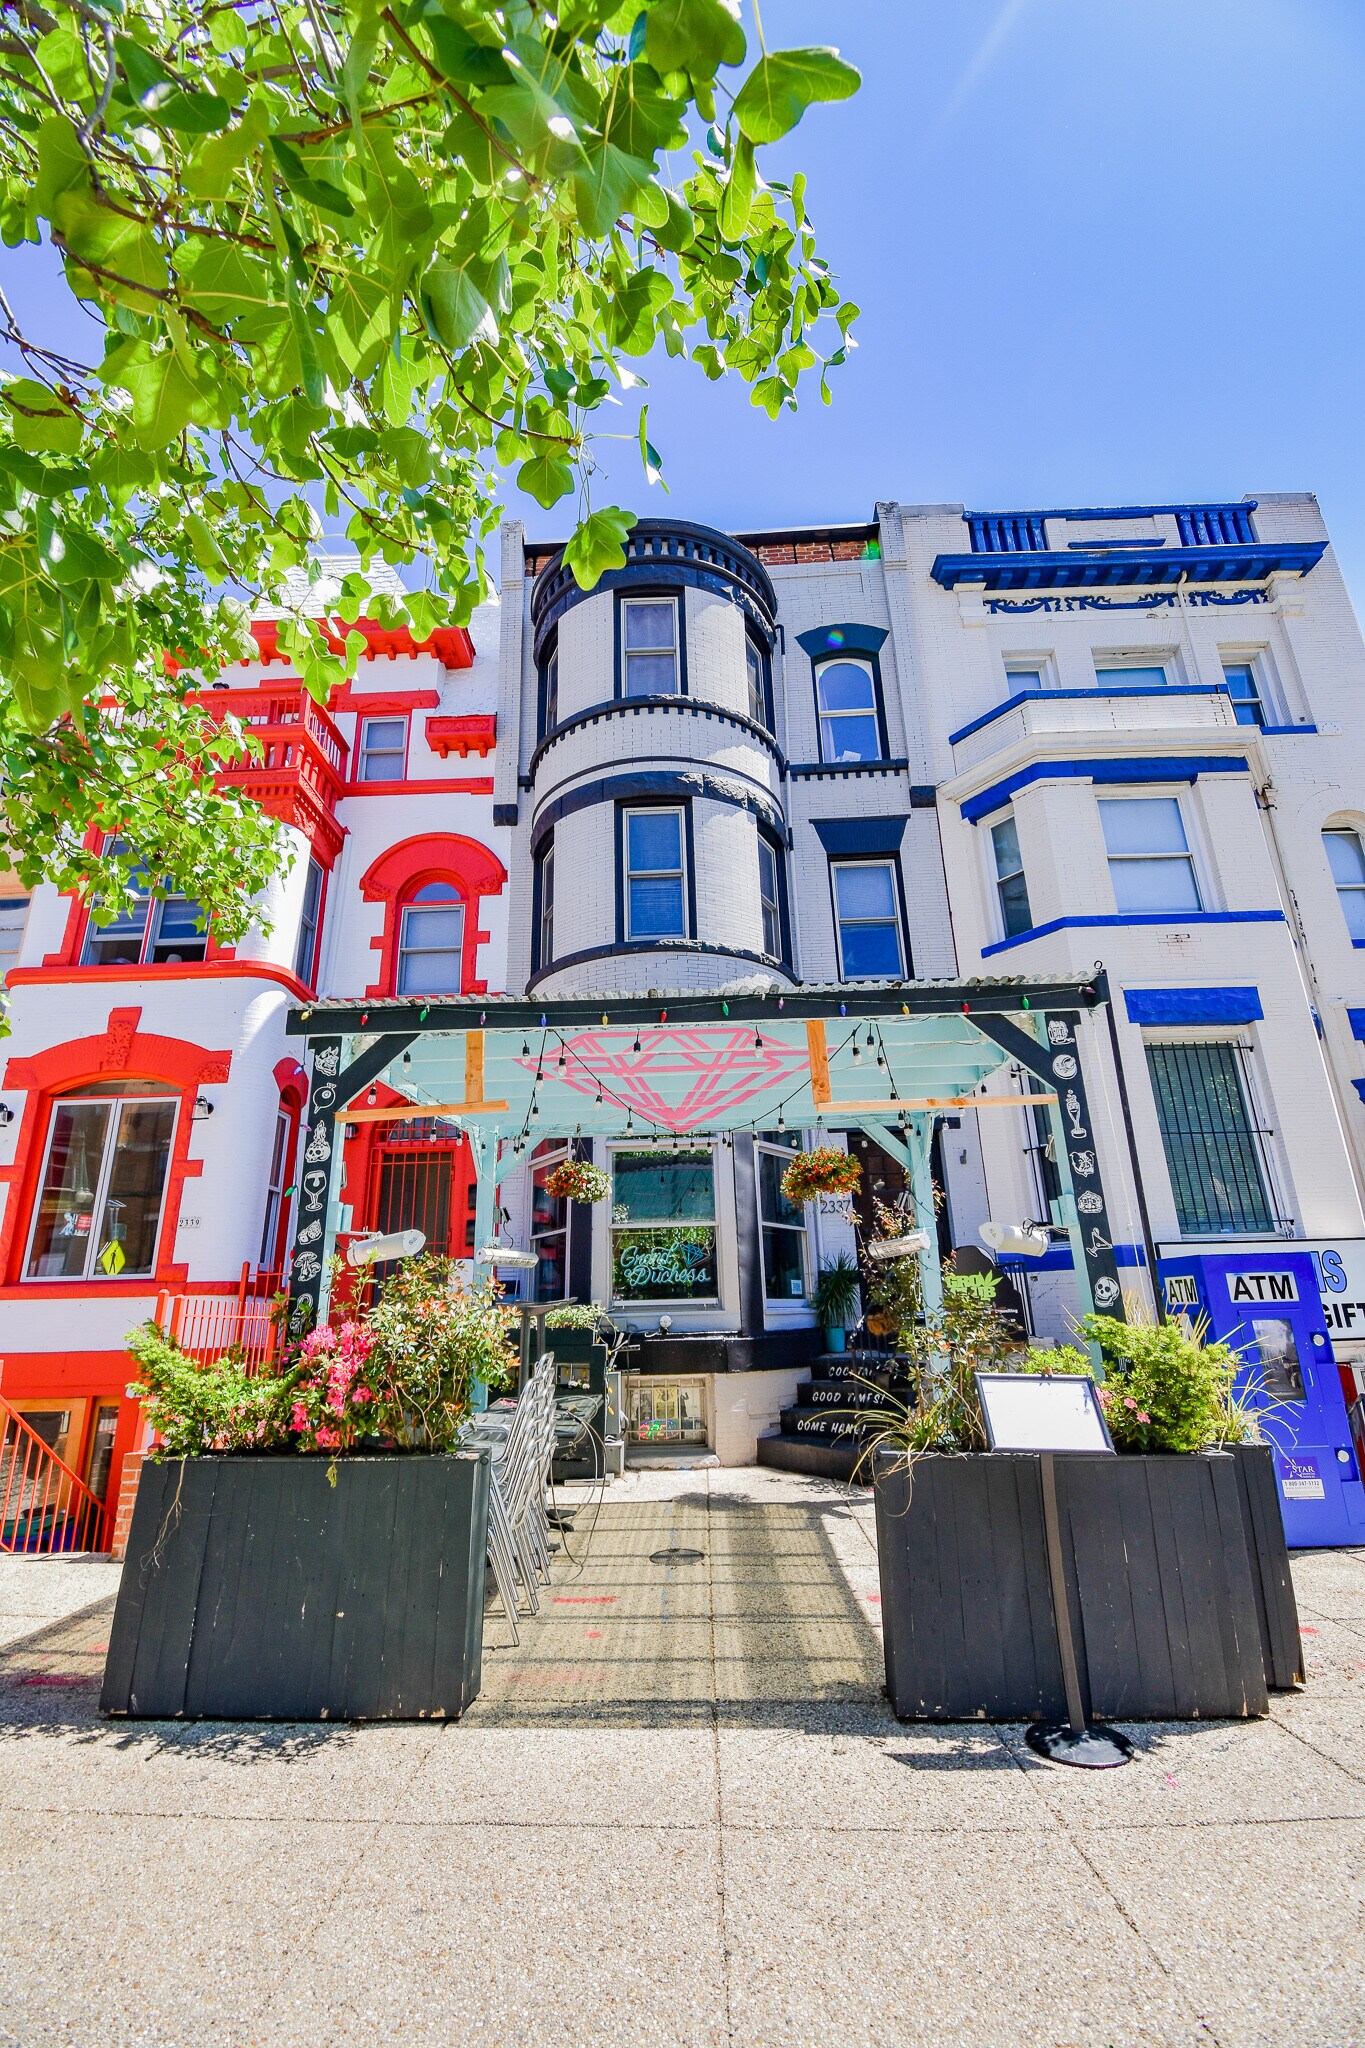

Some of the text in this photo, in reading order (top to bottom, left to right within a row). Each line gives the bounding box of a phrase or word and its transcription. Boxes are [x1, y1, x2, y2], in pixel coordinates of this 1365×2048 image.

[820, 1199, 851, 1214] 2337
[179, 1218, 200, 1227] 2339
[620, 1241, 680, 1268] Grand
[624, 1262, 711, 1287] Duchess
[1169, 1279, 1198, 1302] ATM
[1233, 1275, 1294, 1301] ATM
[812, 1391, 841, 1402] GOOD
[797, 1420, 827, 1432] COME
[1292, 1465, 1315, 1473] STAR
